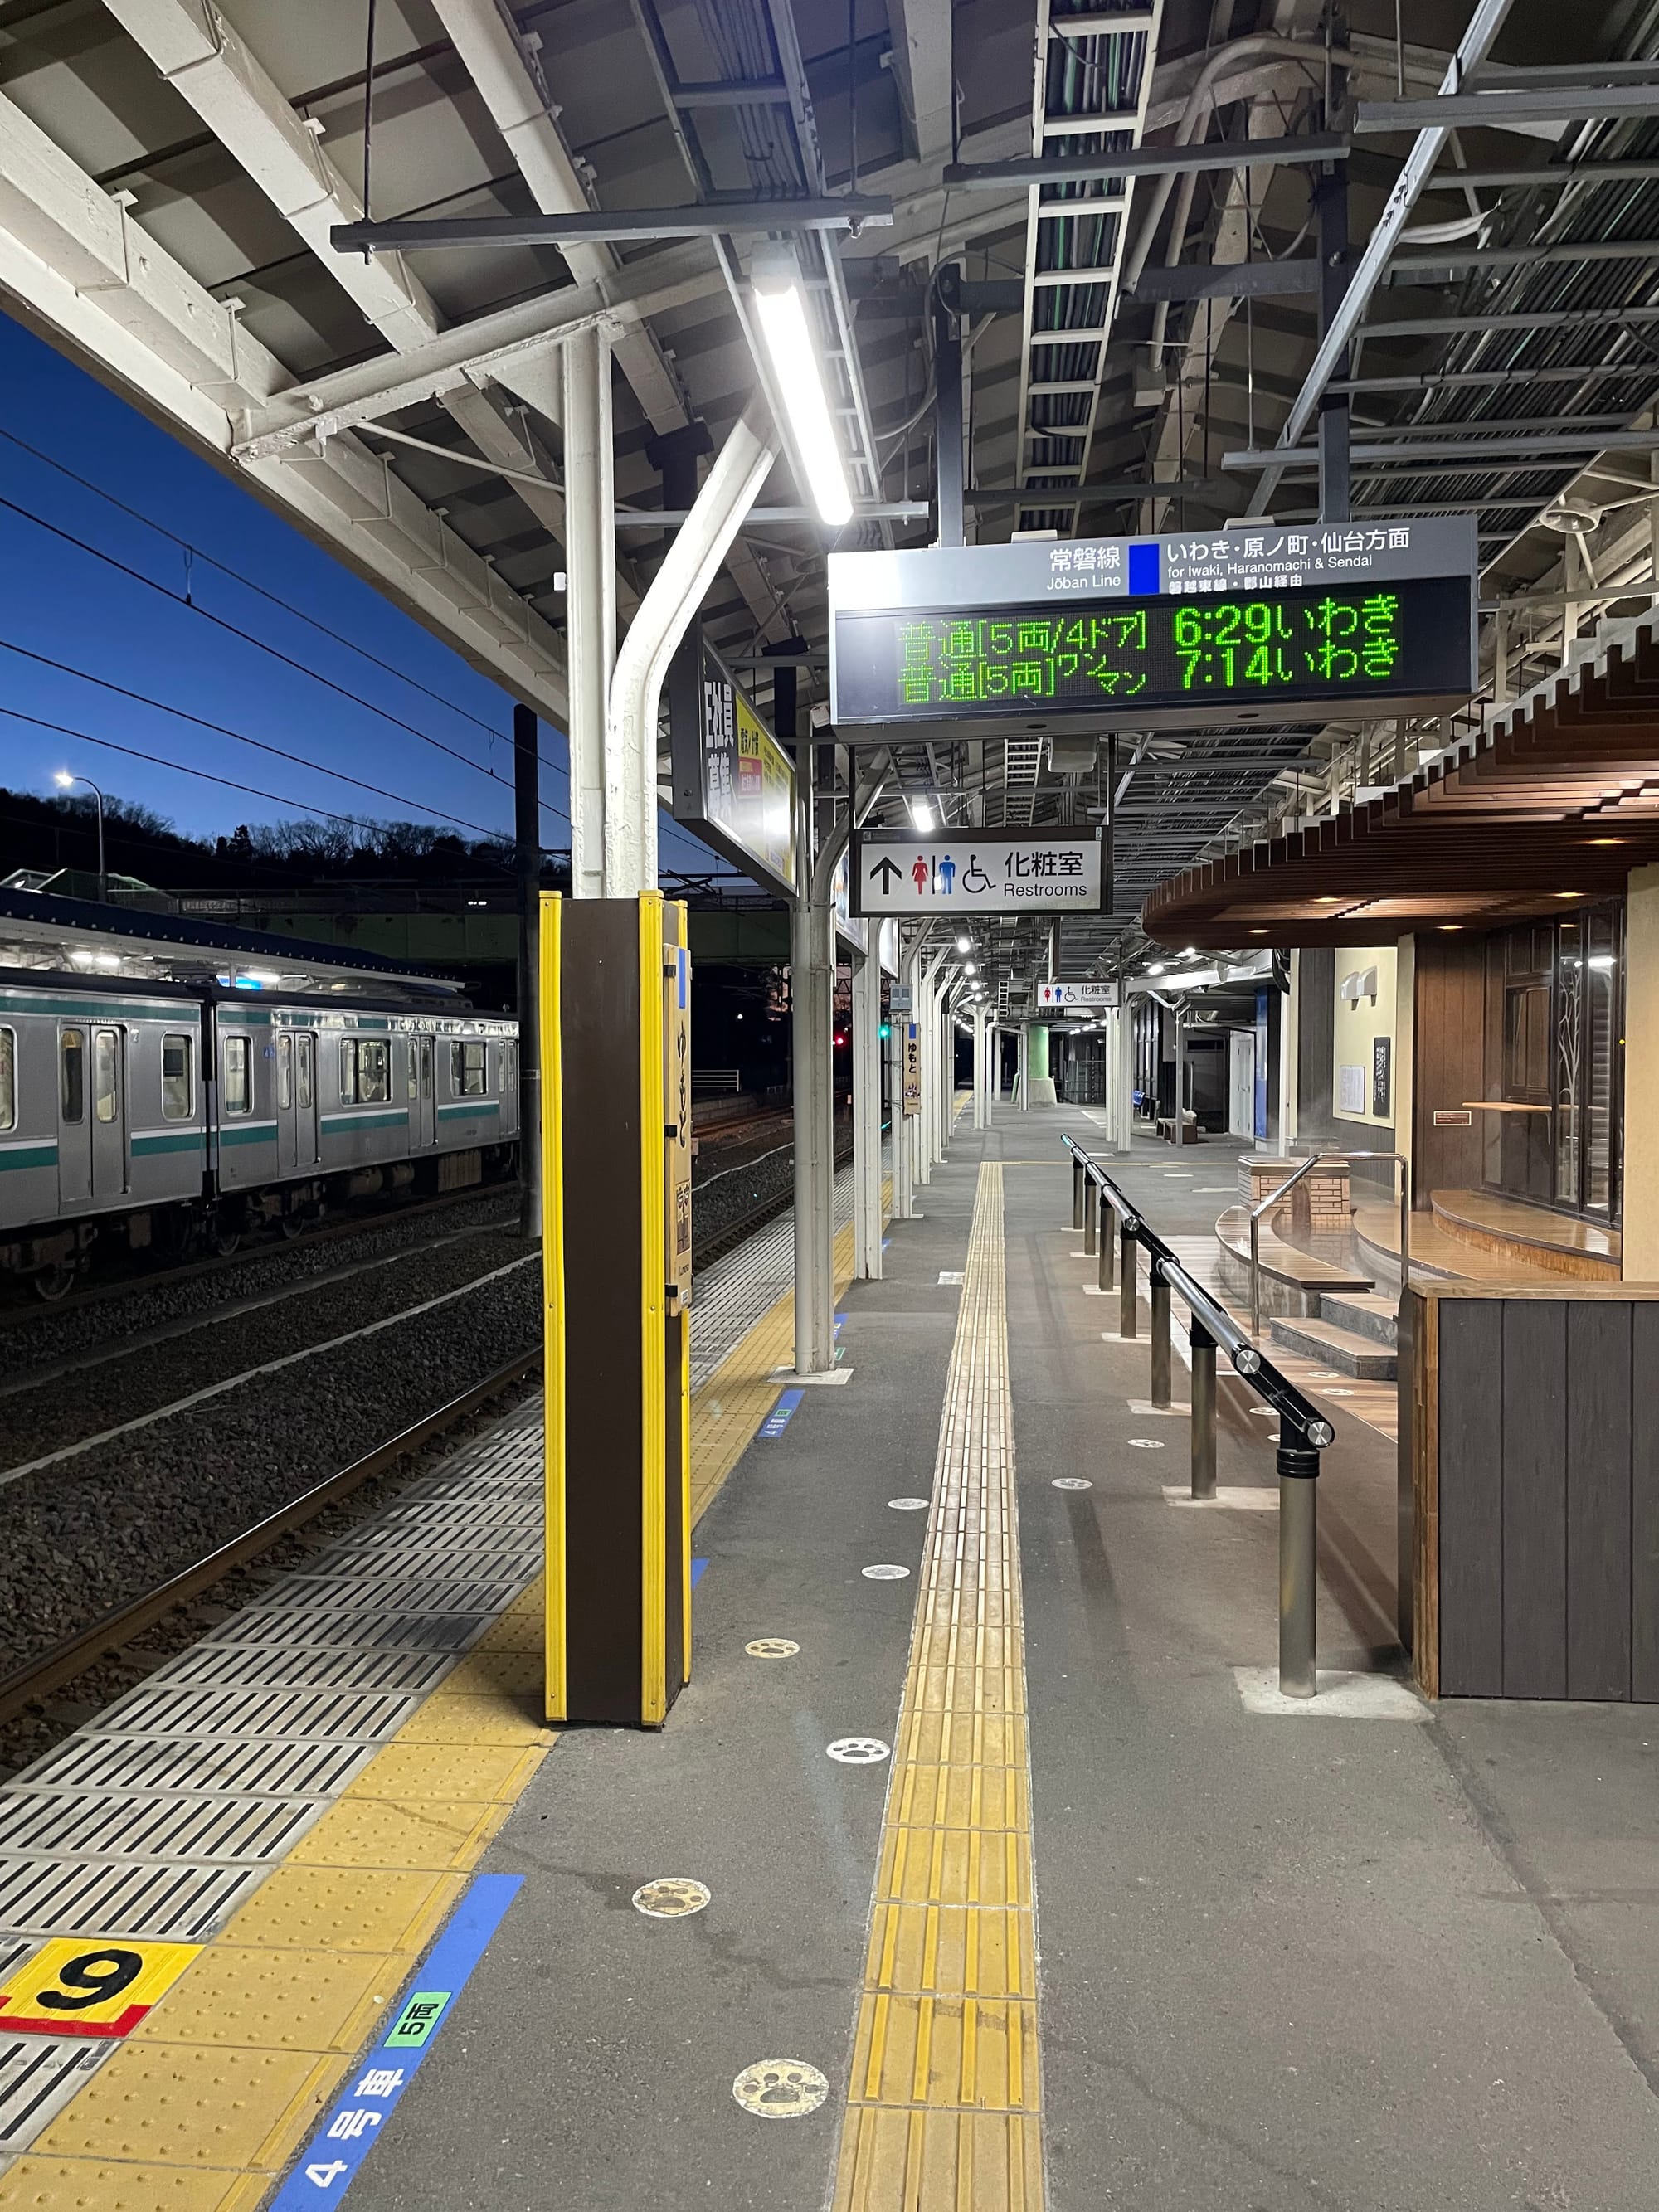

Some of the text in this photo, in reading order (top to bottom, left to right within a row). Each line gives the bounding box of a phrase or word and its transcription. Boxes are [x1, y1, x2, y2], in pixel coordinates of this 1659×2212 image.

[1049, 546, 1121, 572] 常磐線
[1167, 527, 1410, 562] いわき・原ノ町・仙台方面
[1047, 574, 1121, 591] Jōban Line
[1168, 554, 1372, 579] for Iwaki, Haranomachi & Sendai
[1175, 603, 1272, 647] 6:29
[1276, 594, 1399, 639] いわき
[1175, 645, 1274, 689] 7:14
[1276, 636, 1399, 681] いわき
[1004, 852, 1084, 878] 化粧室
[1004, 883, 1087, 897] Restrooms
[908, 1043, 917, 1074] ゆもと
[677, 1020, 687, 1149] ゆもと
[36, 1949, 143, 2010] 9
[397, 2002, 440, 2036] 5両
[304, 2068, 405, 2189] 4号車
